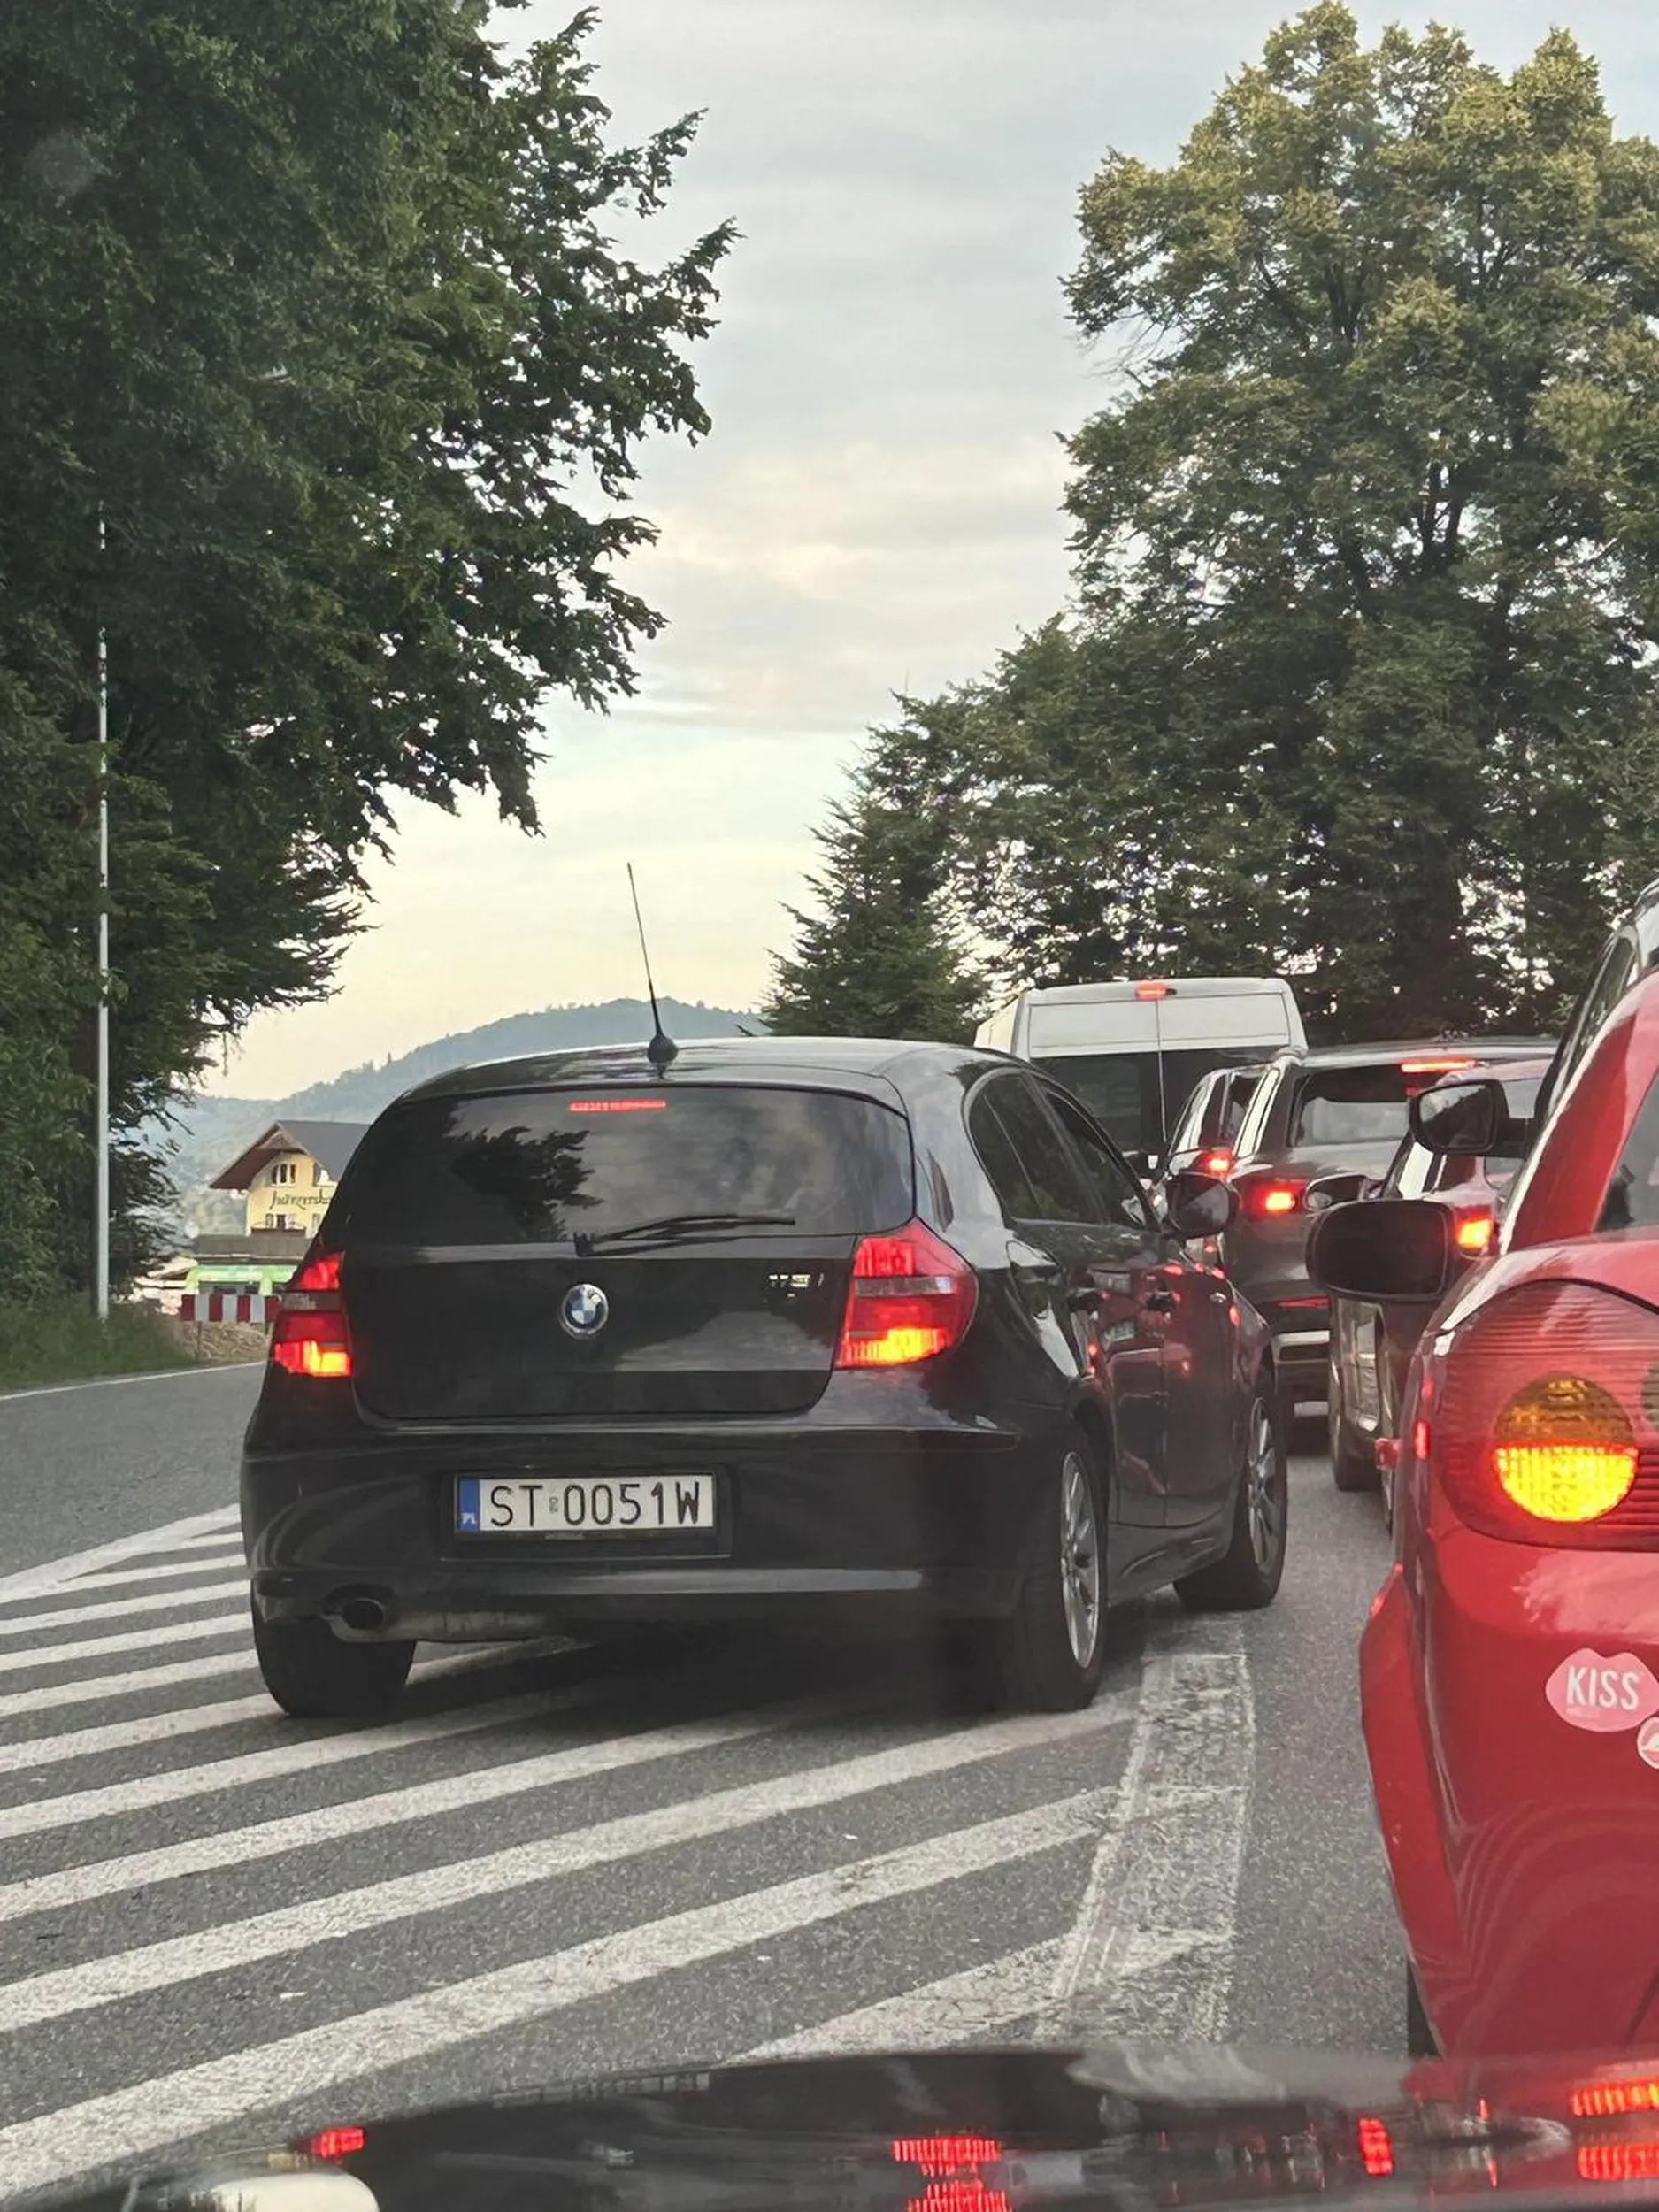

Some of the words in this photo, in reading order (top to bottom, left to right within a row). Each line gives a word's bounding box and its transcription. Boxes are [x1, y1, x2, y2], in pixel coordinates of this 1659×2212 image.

[489, 1485, 543, 1527] ST
[563, 1481, 700, 1525] 0051W
[1566, 1666, 1640, 1710] KISS
